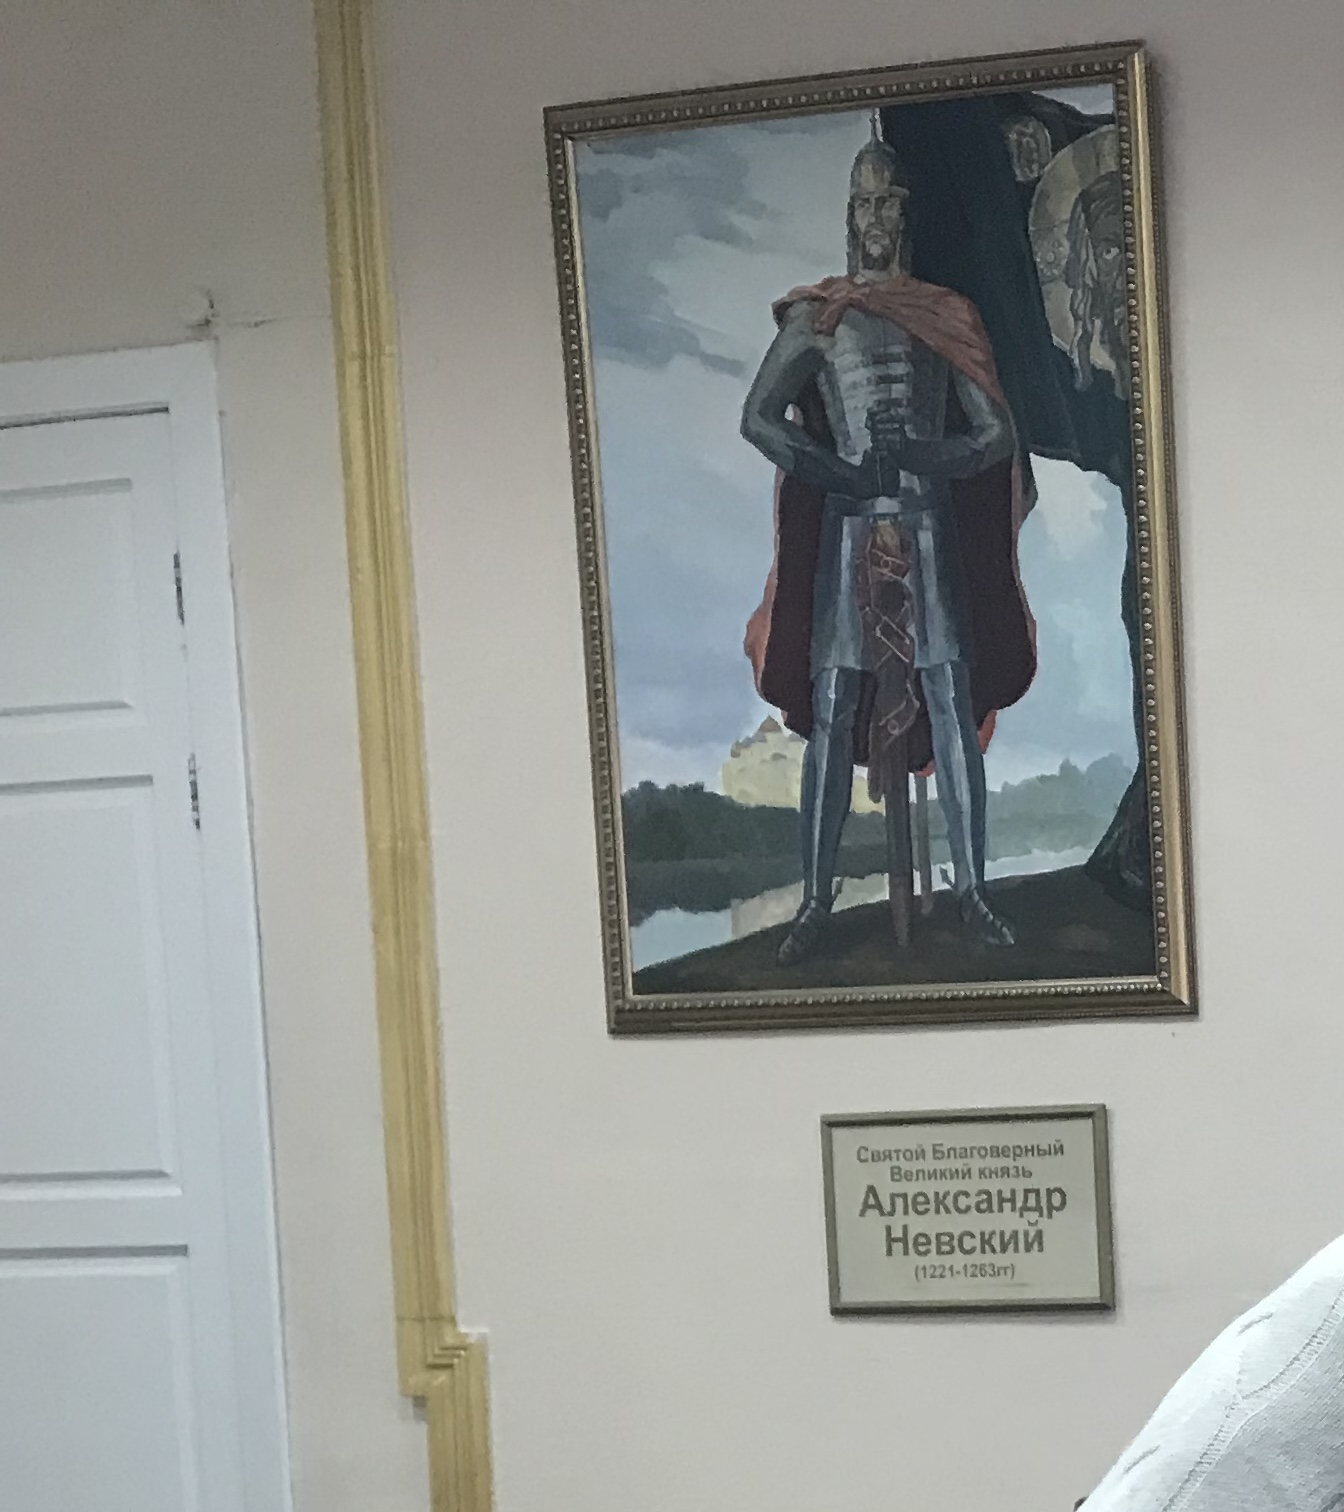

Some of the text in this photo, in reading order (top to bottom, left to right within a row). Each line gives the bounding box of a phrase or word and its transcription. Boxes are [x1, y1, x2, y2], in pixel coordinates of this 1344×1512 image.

[857, 1139, 1064, 1163] Святой Благоверный
[890, 1163, 1033, 1182] Великий князь
[859, 1184, 1067, 1219] Александр
[885, 1219, 1044, 1256] Невский
